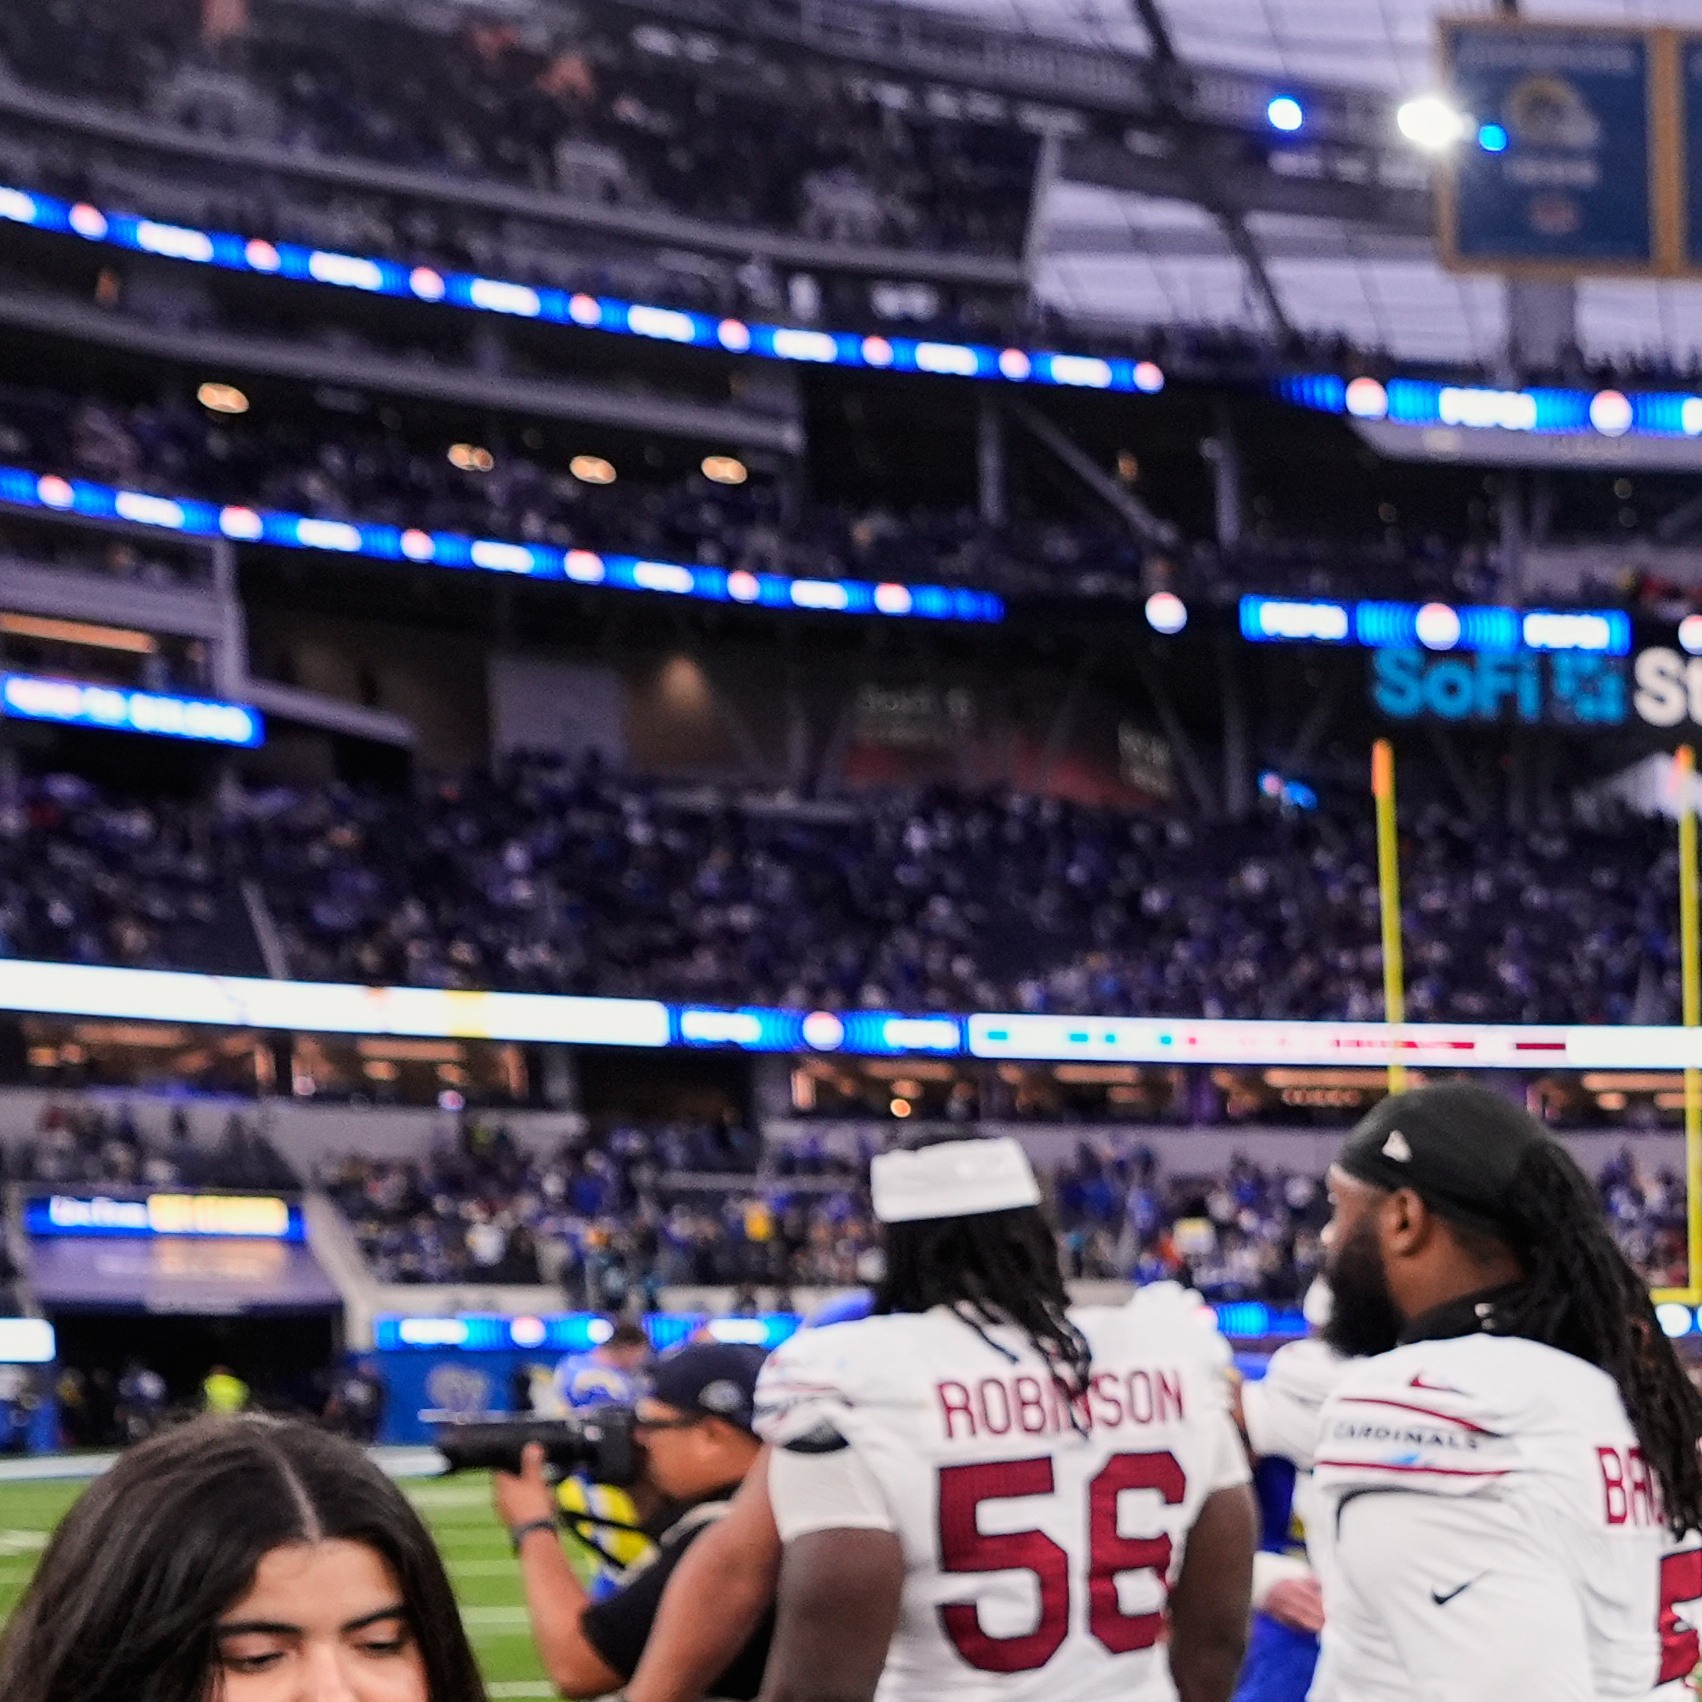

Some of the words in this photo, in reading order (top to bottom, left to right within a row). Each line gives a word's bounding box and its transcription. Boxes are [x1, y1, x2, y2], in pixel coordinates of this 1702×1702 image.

[1374, 647, 1540, 720] SoFi
[1333, 1420, 1480, 1451] CARDINALS
[940, 1451, 1186, 1674] 56
